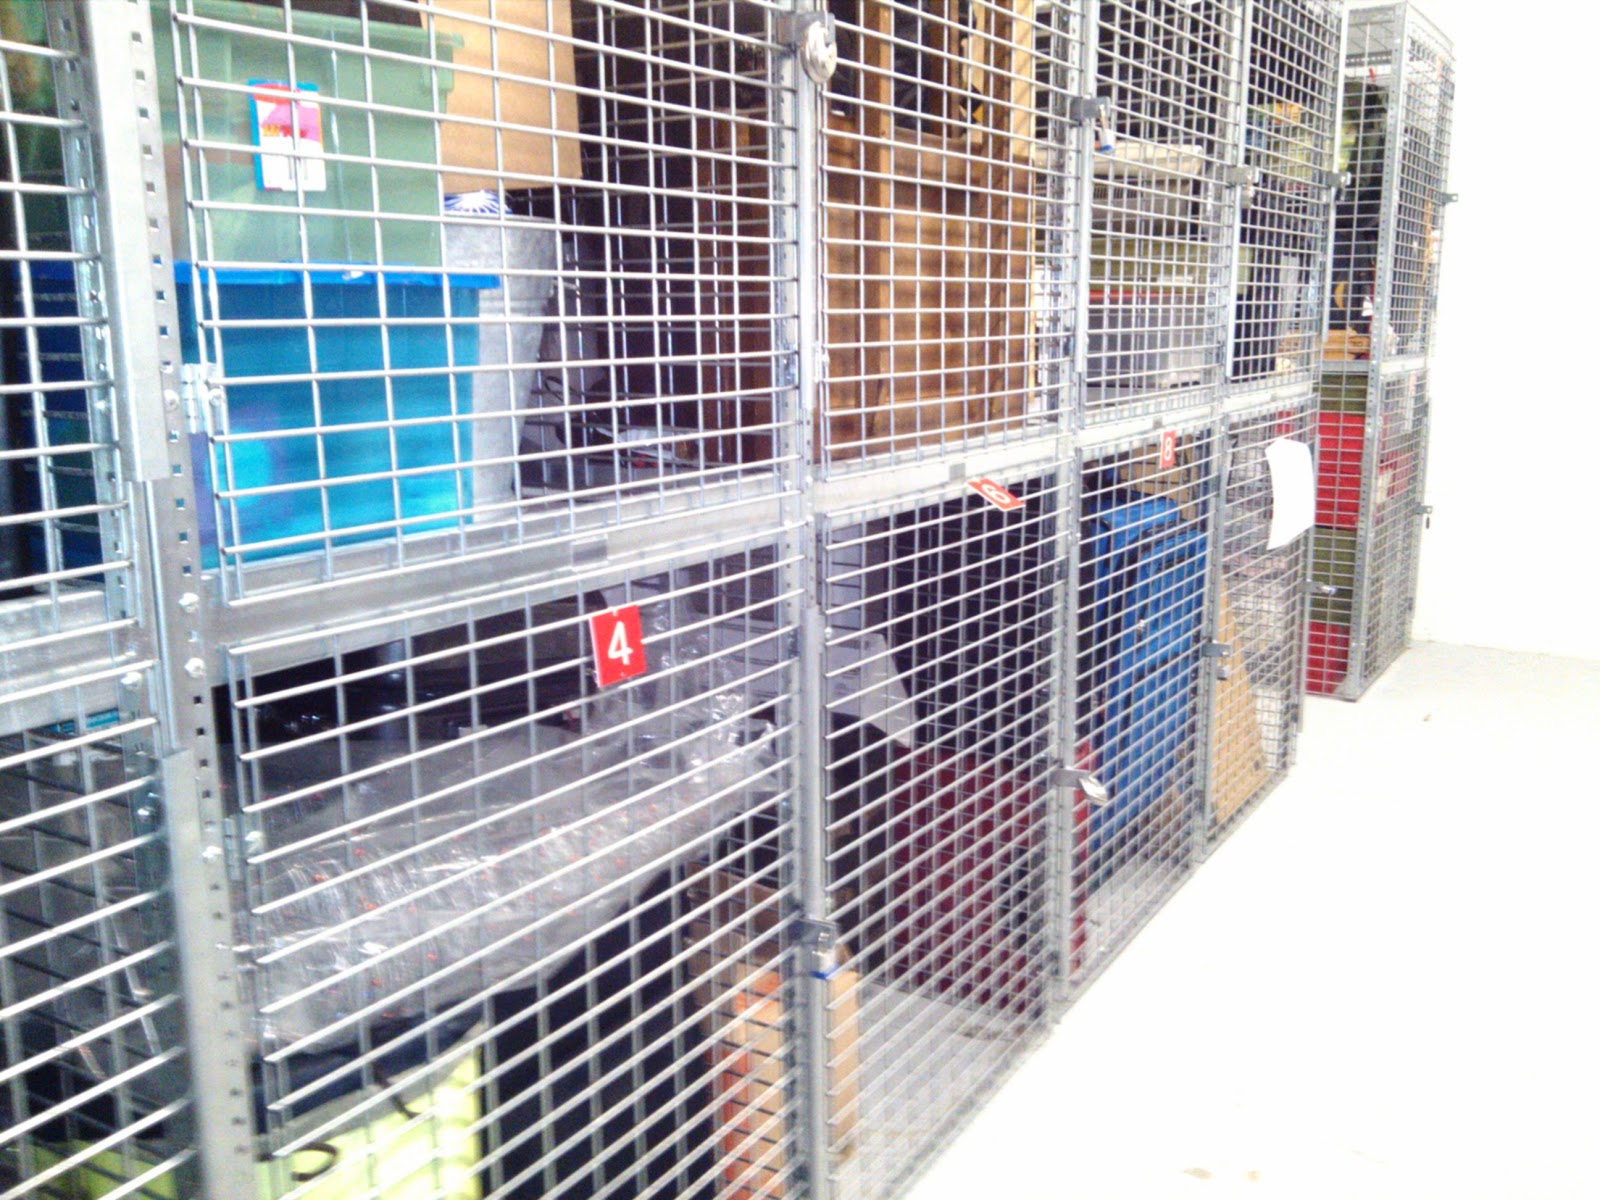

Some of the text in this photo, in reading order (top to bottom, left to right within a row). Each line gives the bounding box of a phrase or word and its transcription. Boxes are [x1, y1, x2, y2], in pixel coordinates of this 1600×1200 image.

[1164, 436, 1173, 461] 8
[981, 483, 1011, 504] 6
[607, 620, 634, 665] 4
